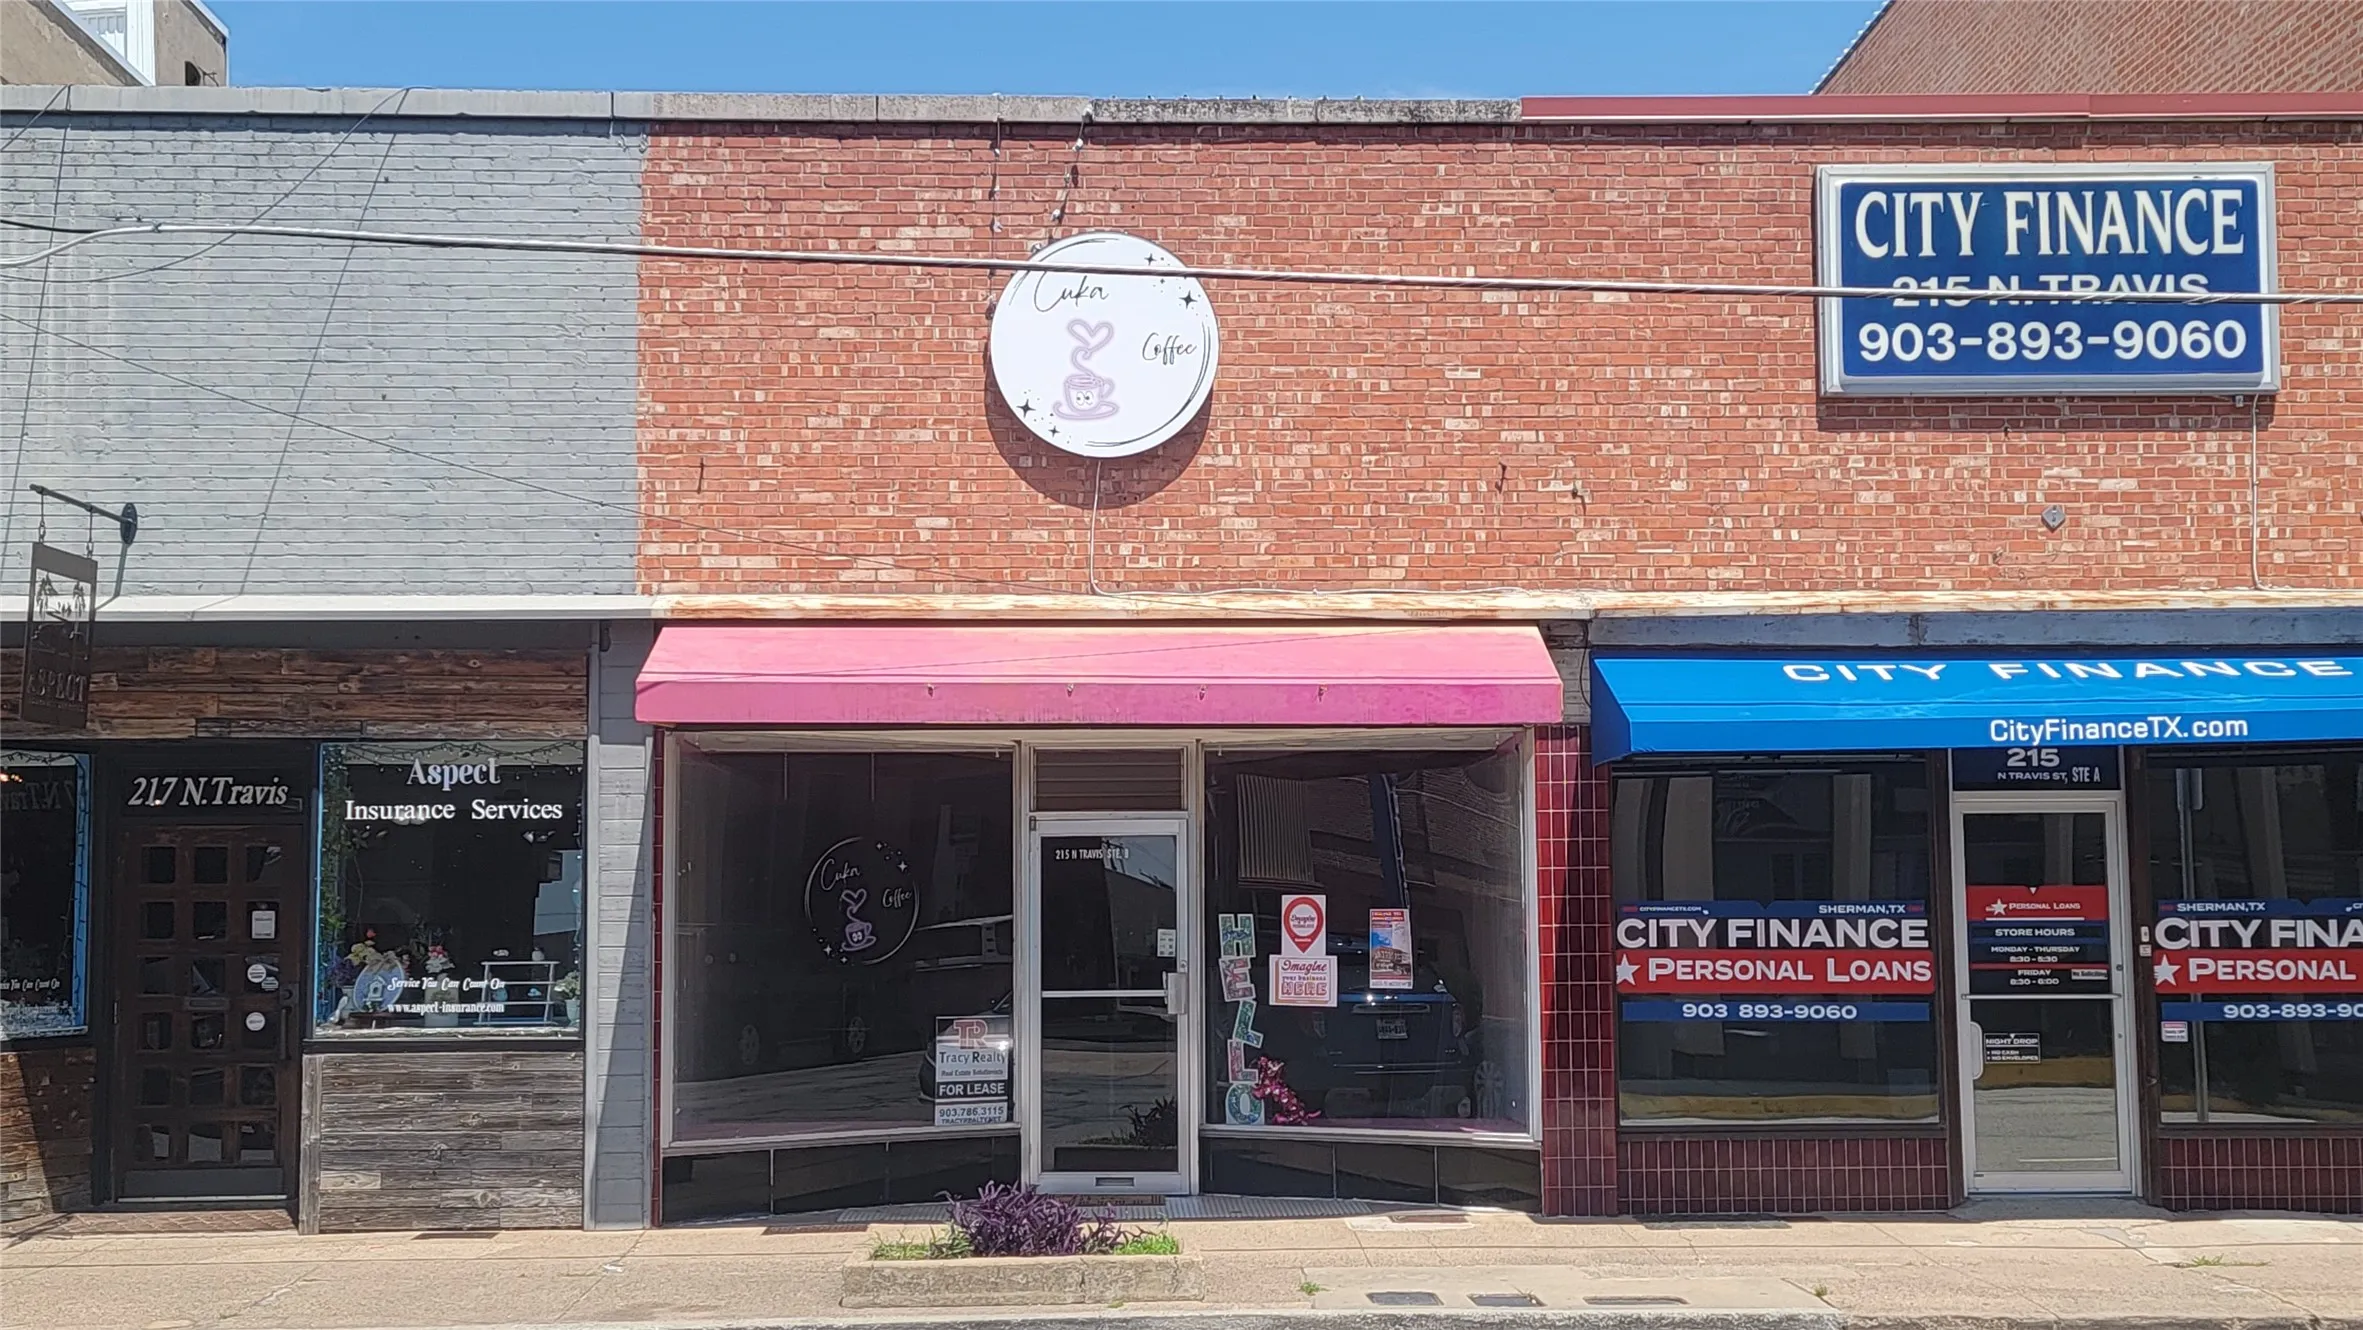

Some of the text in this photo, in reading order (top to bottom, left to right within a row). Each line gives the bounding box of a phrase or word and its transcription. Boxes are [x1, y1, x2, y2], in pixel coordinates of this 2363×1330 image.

[1855, 188, 2244, 258] CITY FINANCE
[1034, 271, 1109, 313] Cuka
[1892, 276, 1971, 307] 215
[1142, 332, 1198, 366] Coffee
[1858, 320, 2247, 362] 903-893-9060
[1783, 660, 2354, 681] CITY FINANCE
[1990, 715, 2249, 746] CityFinanceTX.com
[2007, 748, 2060, 767] 215
[406, 758, 502, 791] Aspect
[1997, 766, 2101, 784] N TRAVIS ST, STE A
[127, 776, 179, 806] 217
[344, 798, 563, 821] Insurance Services
[1055, 849, 1070, 860] 215
[1071, 849, 1078, 860] N
[1079, 848, 1104, 859] TRAVIS
[1818, 904, 1906, 914] SHERMAN,TX
[2009, 902, 2051, 910] PERSONAL
[2177, 902, 2266, 912] SHERMAN,TX
[1616, 918, 1929, 949] CITY FINANCE
[1995, 928, 2075, 936] STORE HOURS
[2155, 917, 2262, 949] CITY
[1281, 960, 1328, 975] Imagine
[1648, 958, 1932, 982] PERSONAL LOANS
[2188, 957, 2357, 982] PERSONAL
[387, 977, 420, 991] Service
[421, 977, 437, 990] You
[441, 978, 459, 991] Can
[1281, 981, 1328, 996] HERE
[1682, 1004, 1858, 1019] 903 893-9060
[939, 1051, 1005, 1064] Tracy Realty
[939, 1082, 1005, 1096] FOR LEASE
[939, 1106, 1004, 1117] 903.786.3115
